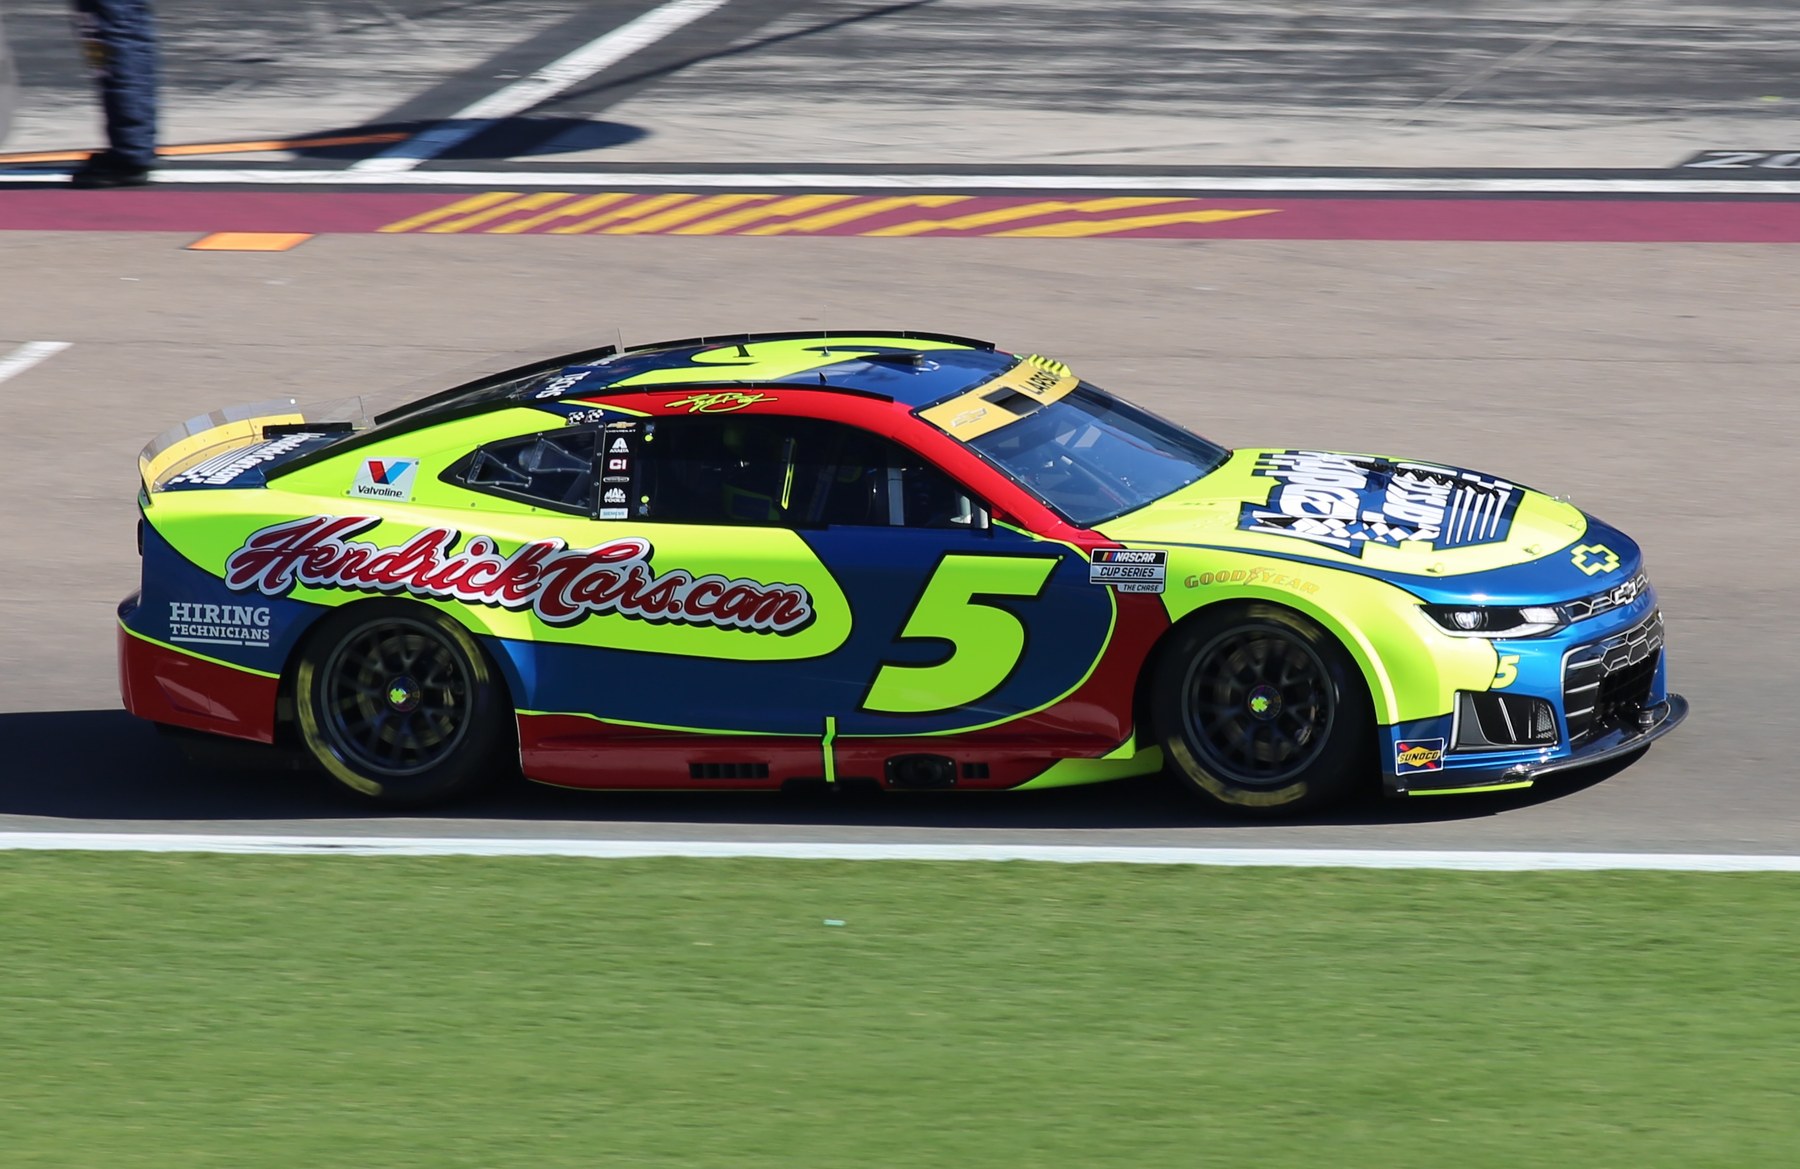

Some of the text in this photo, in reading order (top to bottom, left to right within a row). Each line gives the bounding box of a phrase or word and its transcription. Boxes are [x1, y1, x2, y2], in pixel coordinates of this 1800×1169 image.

[357, 484, 404, 499] Valvoline
[1115, 552, 1157, 563] NASCAR
[225, 514, 816, 633] HendrickCars.com
[1100, 566, 1155, 578] CUP SERIES
[1136, 584, 1159, 592] CHASE
[1184, 568, 1321, 595] GOODYEAR
[169, 602, 271, 626] HIRING
[170, 624, 270, 640] TECHNICIANS
[863, 555, 1057, 713] 5
[1491, 655, 1520, 689] 5
[1399, 750, 1440, 763] SUNOCO
